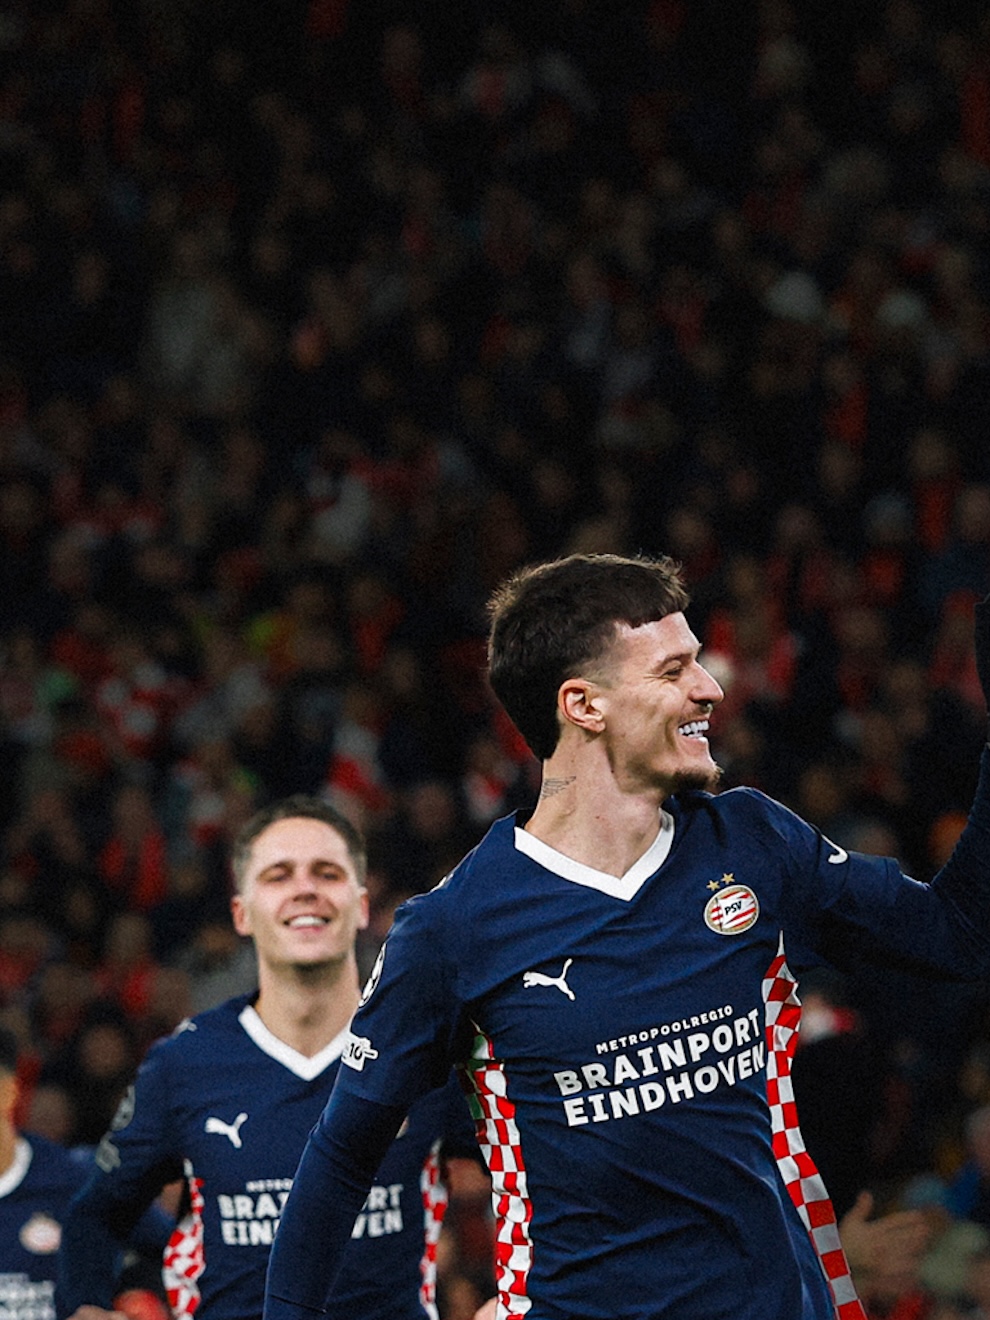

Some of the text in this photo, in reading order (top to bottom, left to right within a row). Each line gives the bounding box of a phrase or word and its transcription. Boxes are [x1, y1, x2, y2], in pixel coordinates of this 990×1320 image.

[725, 900, 742, 915] PSV
[554, 1008, 760, 1096] BRAINPORT
[596, 1005, 733, 1055] METROPOOLREGIO
[563, 1041, 767, 1127] EINDHOVEN
